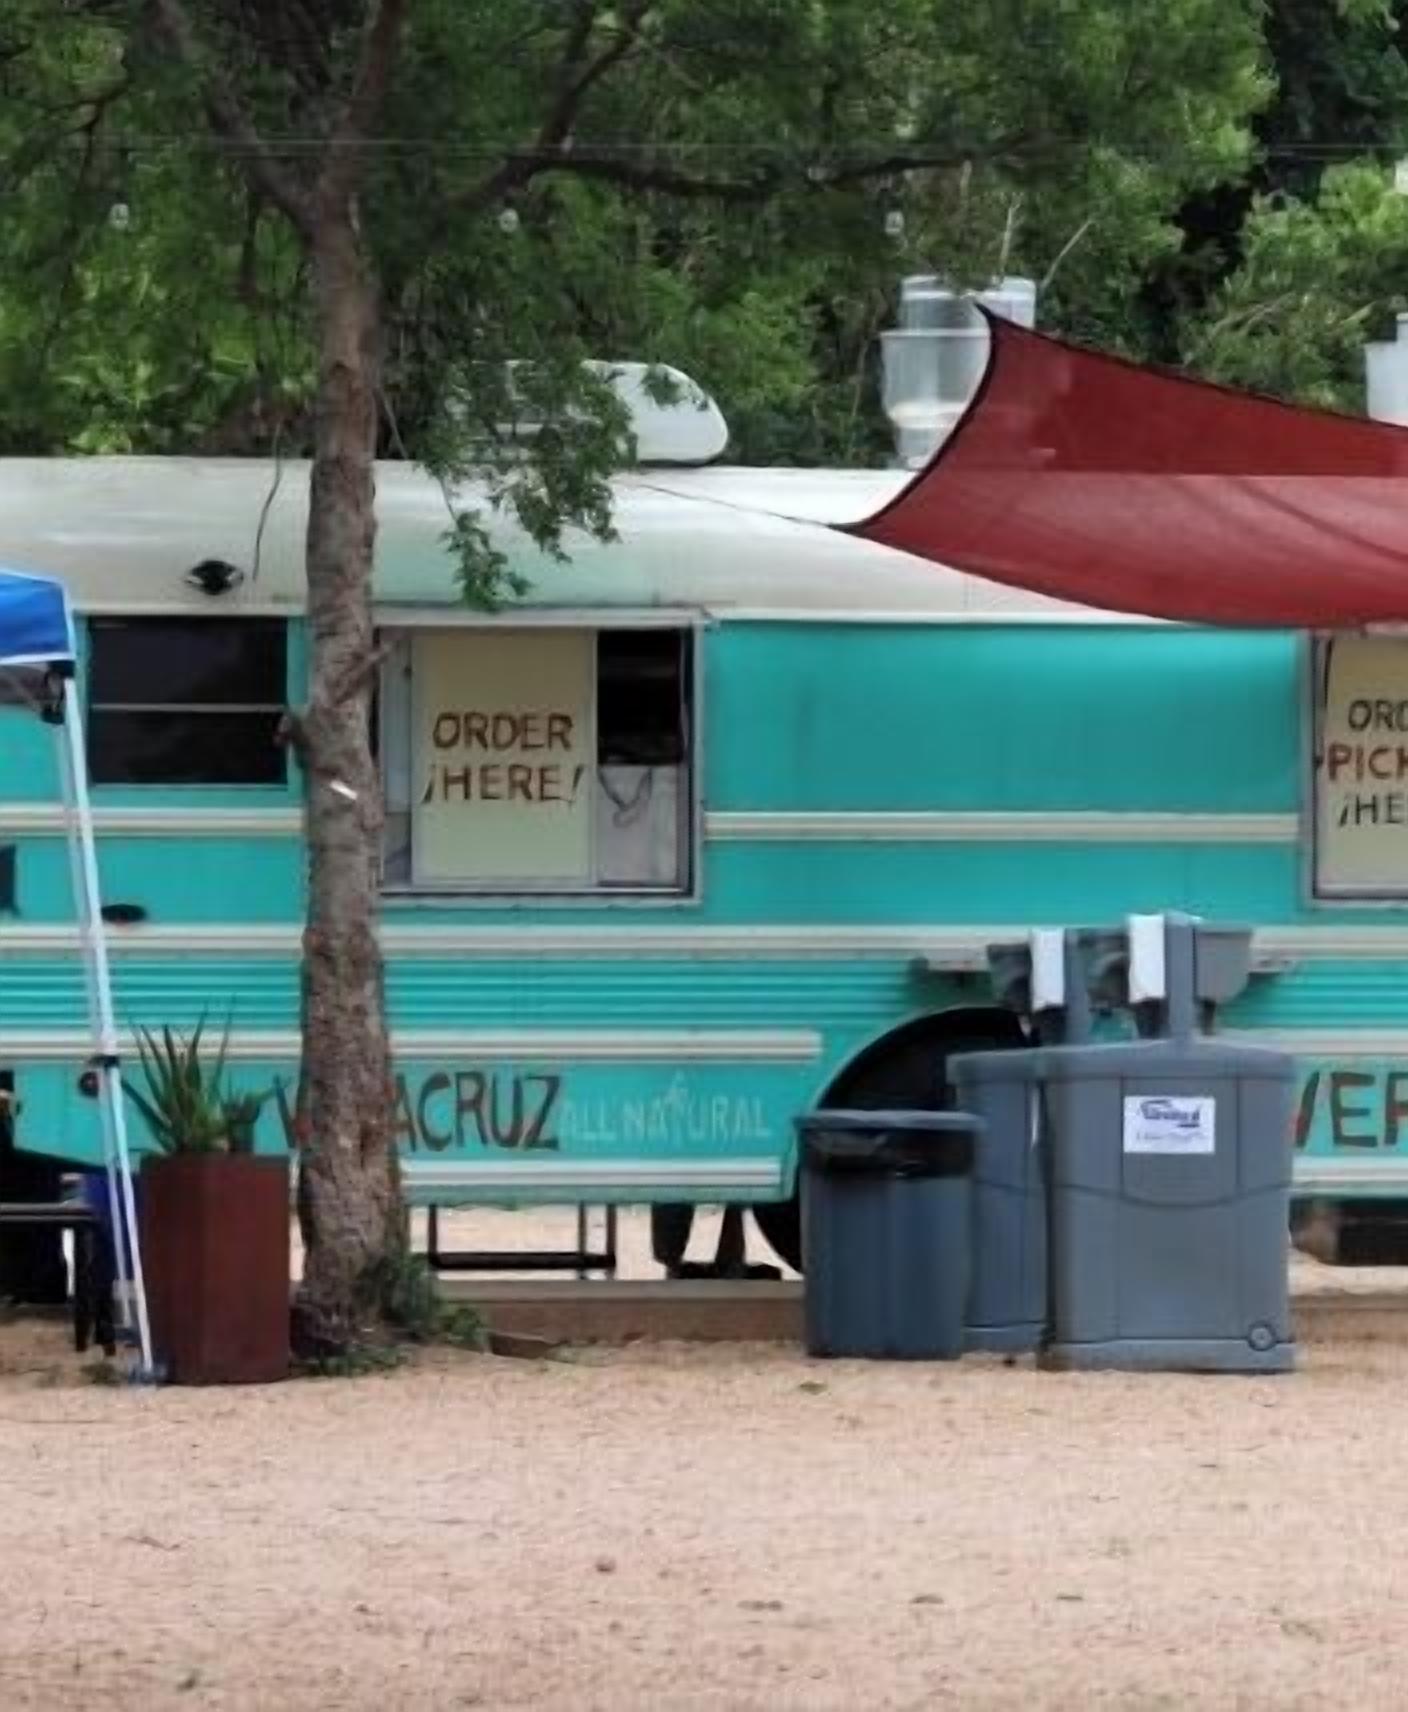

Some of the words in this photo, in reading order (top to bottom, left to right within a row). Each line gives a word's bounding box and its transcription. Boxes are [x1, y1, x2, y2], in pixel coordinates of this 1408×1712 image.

[432, 711, 574, 751] ORDER
[273, 1071, 561, 1151] VACRUZ
[560, 1098, 617, 1141] ALL
[622, 1093, 773, 1148] NATURAL
